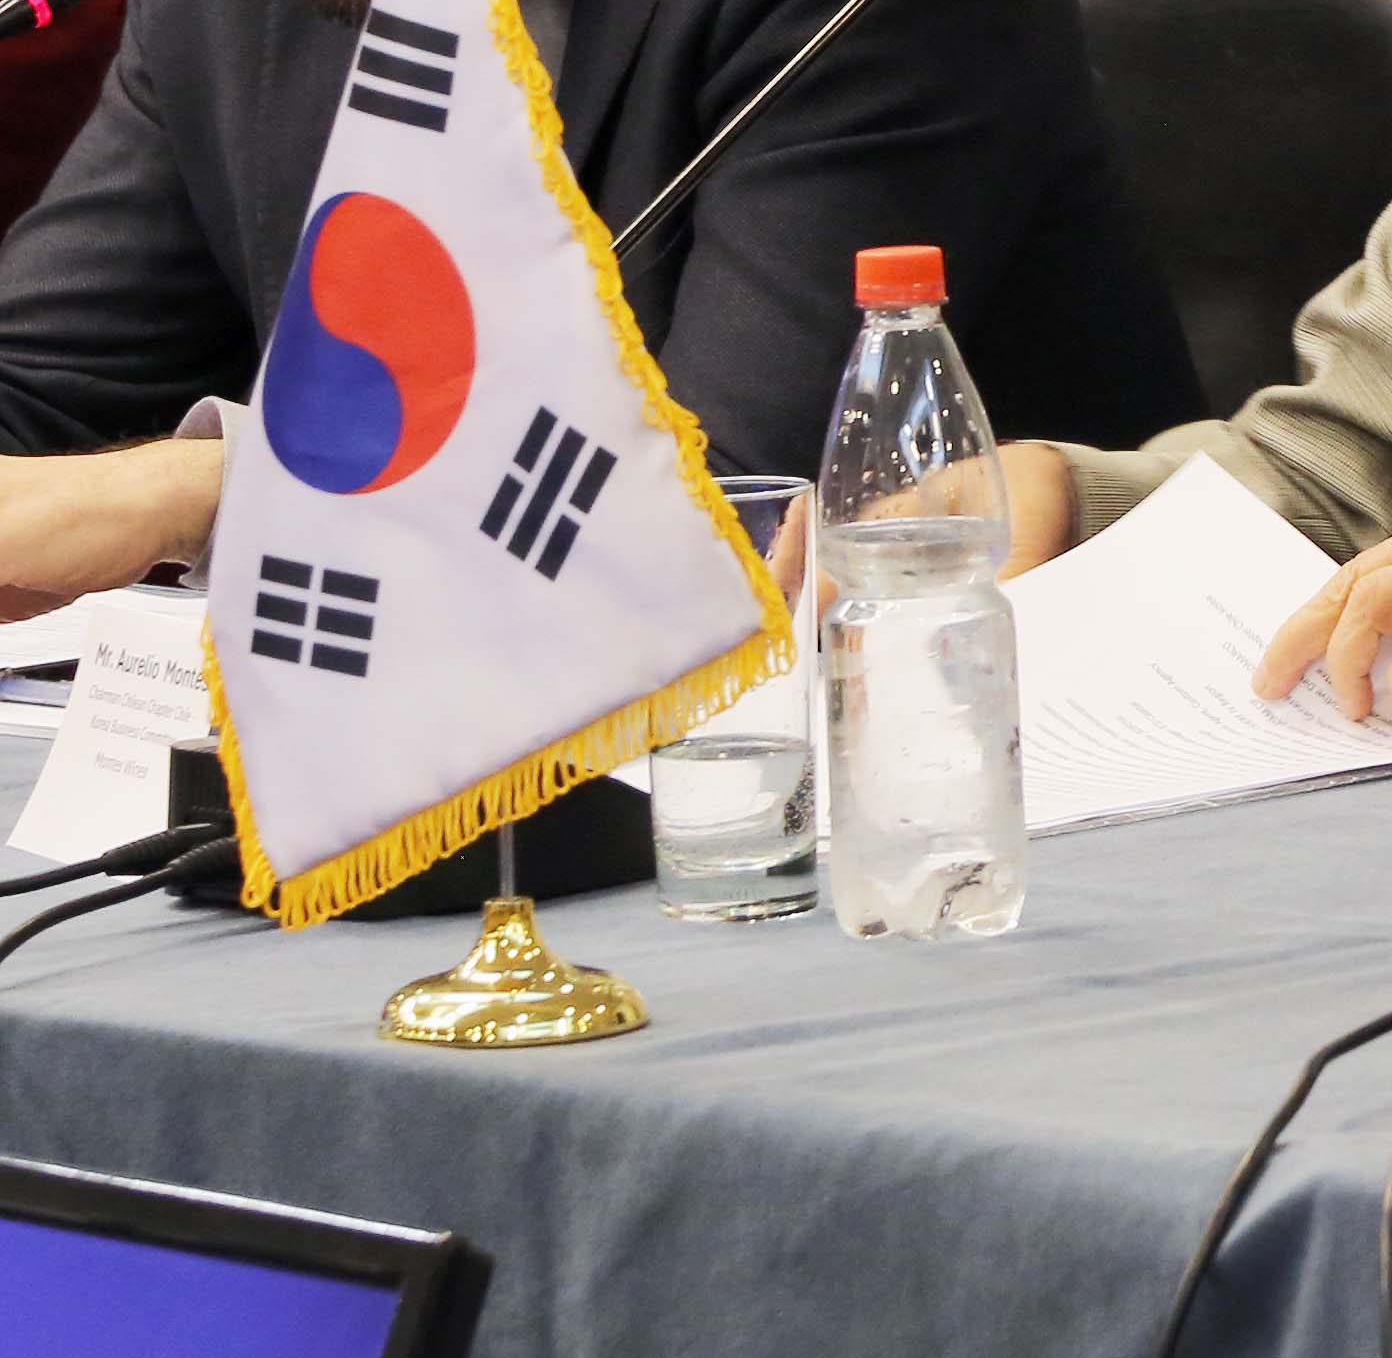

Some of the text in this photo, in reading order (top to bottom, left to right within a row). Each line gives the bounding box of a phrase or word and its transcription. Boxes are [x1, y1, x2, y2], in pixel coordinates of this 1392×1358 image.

[95, 642, 209, 692] Mr. Aurelio Montes
